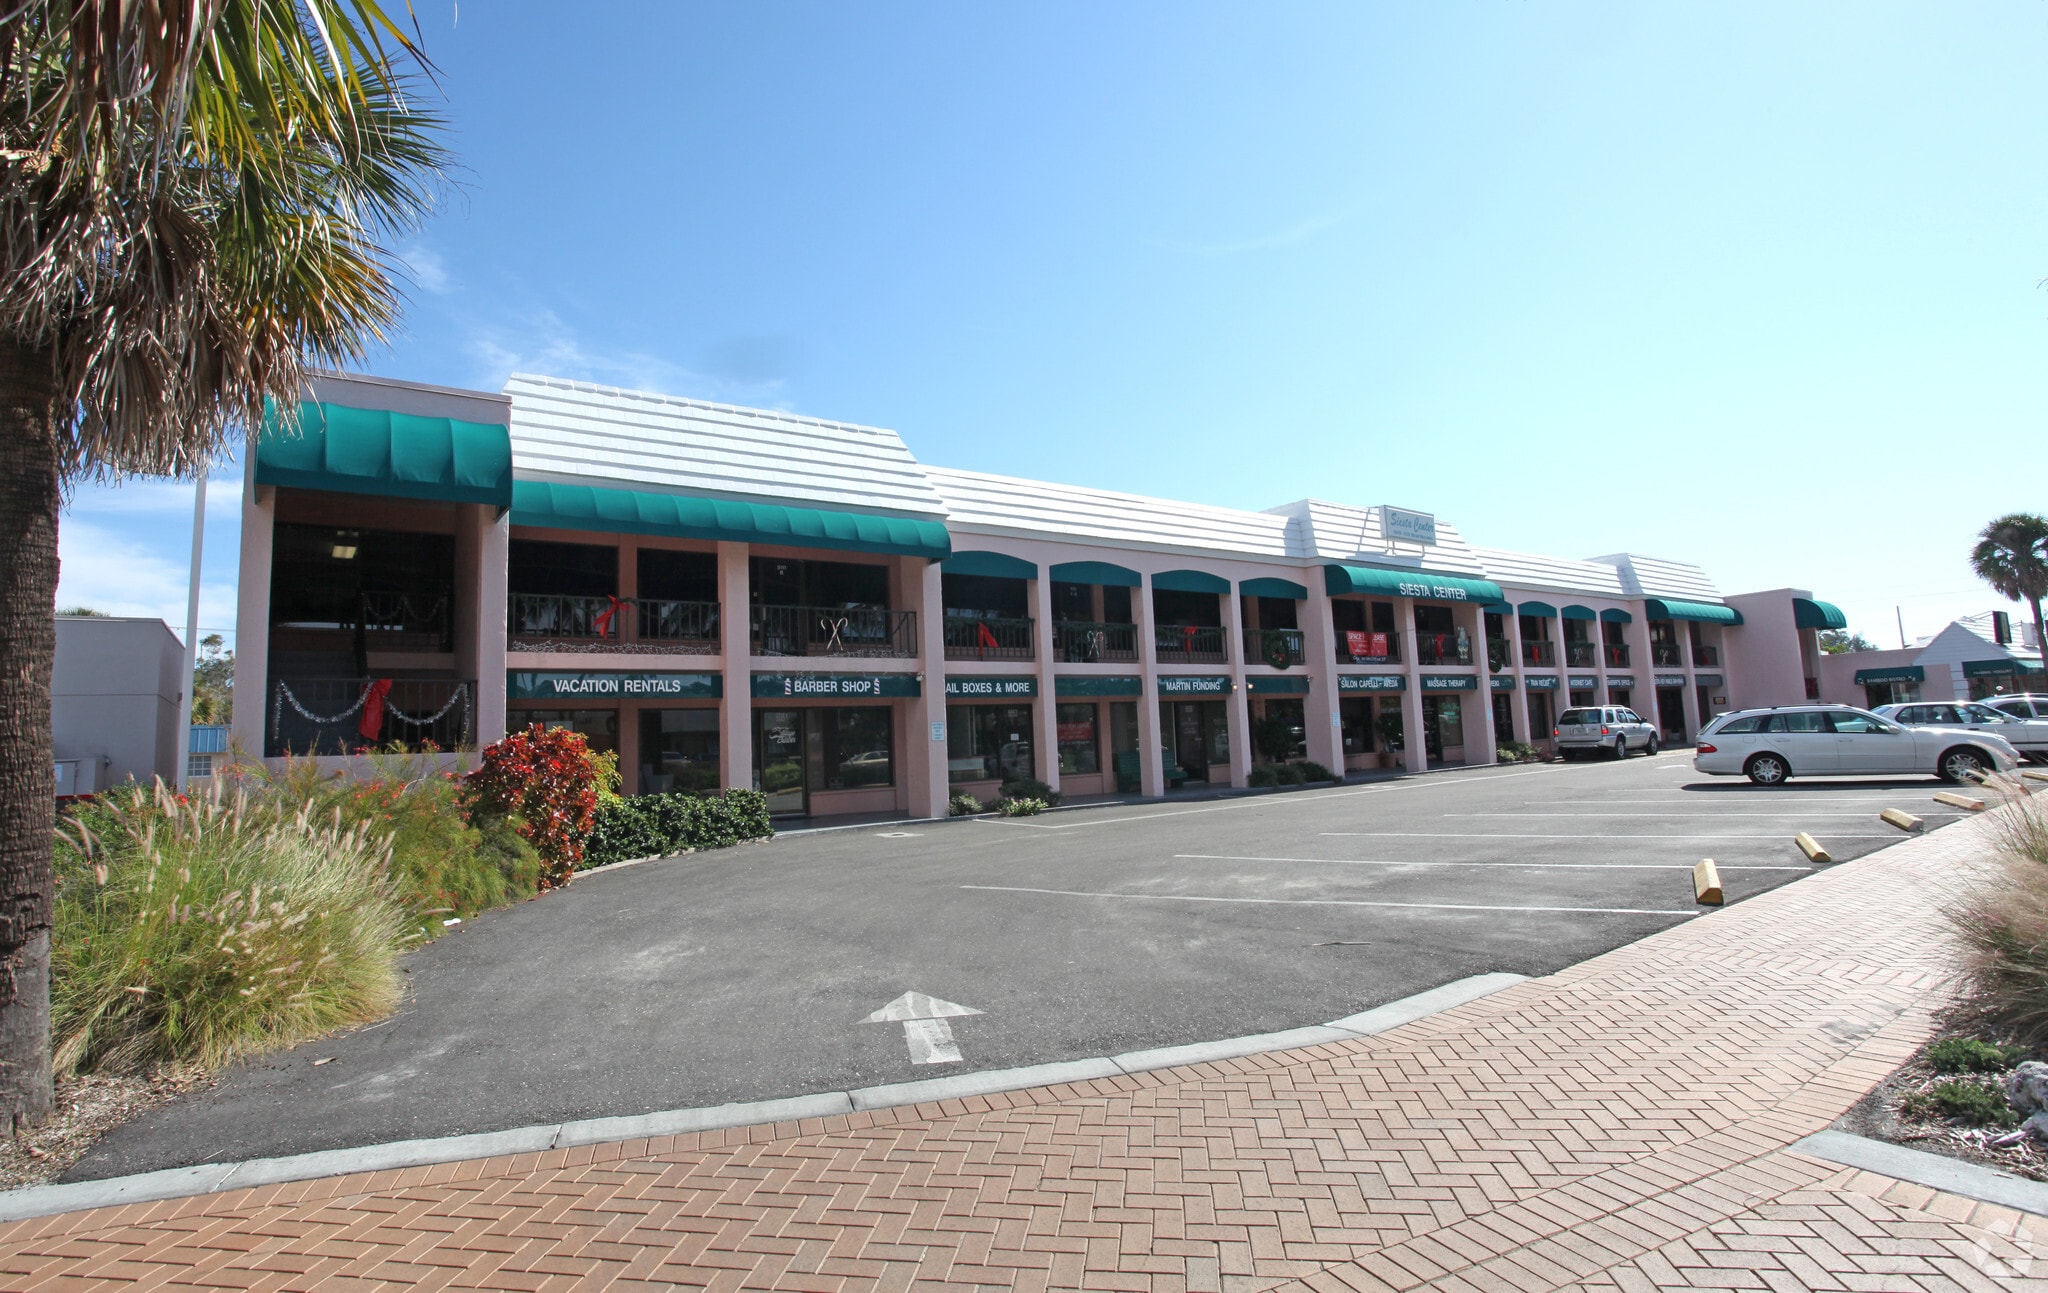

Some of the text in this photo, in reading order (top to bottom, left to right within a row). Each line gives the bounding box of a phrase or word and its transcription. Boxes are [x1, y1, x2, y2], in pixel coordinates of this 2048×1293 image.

[1390, 512, 1435, 533] Siesta Center
[1399, 583, 1467, 600] SIESTA CENTER
[553, 679, 681, 693] VACATION RENTALS
[794, 681, 871, 693] BARBER SHOP
[945, 682, 1030, 693] AIL BOXES & MORE
[1166, 681, 1220, 691] MARTIN FUNDING
[1341, 679, 1358, 688] SALON
[1427, 679, 1466, 687] MASSAGE THERAPY
